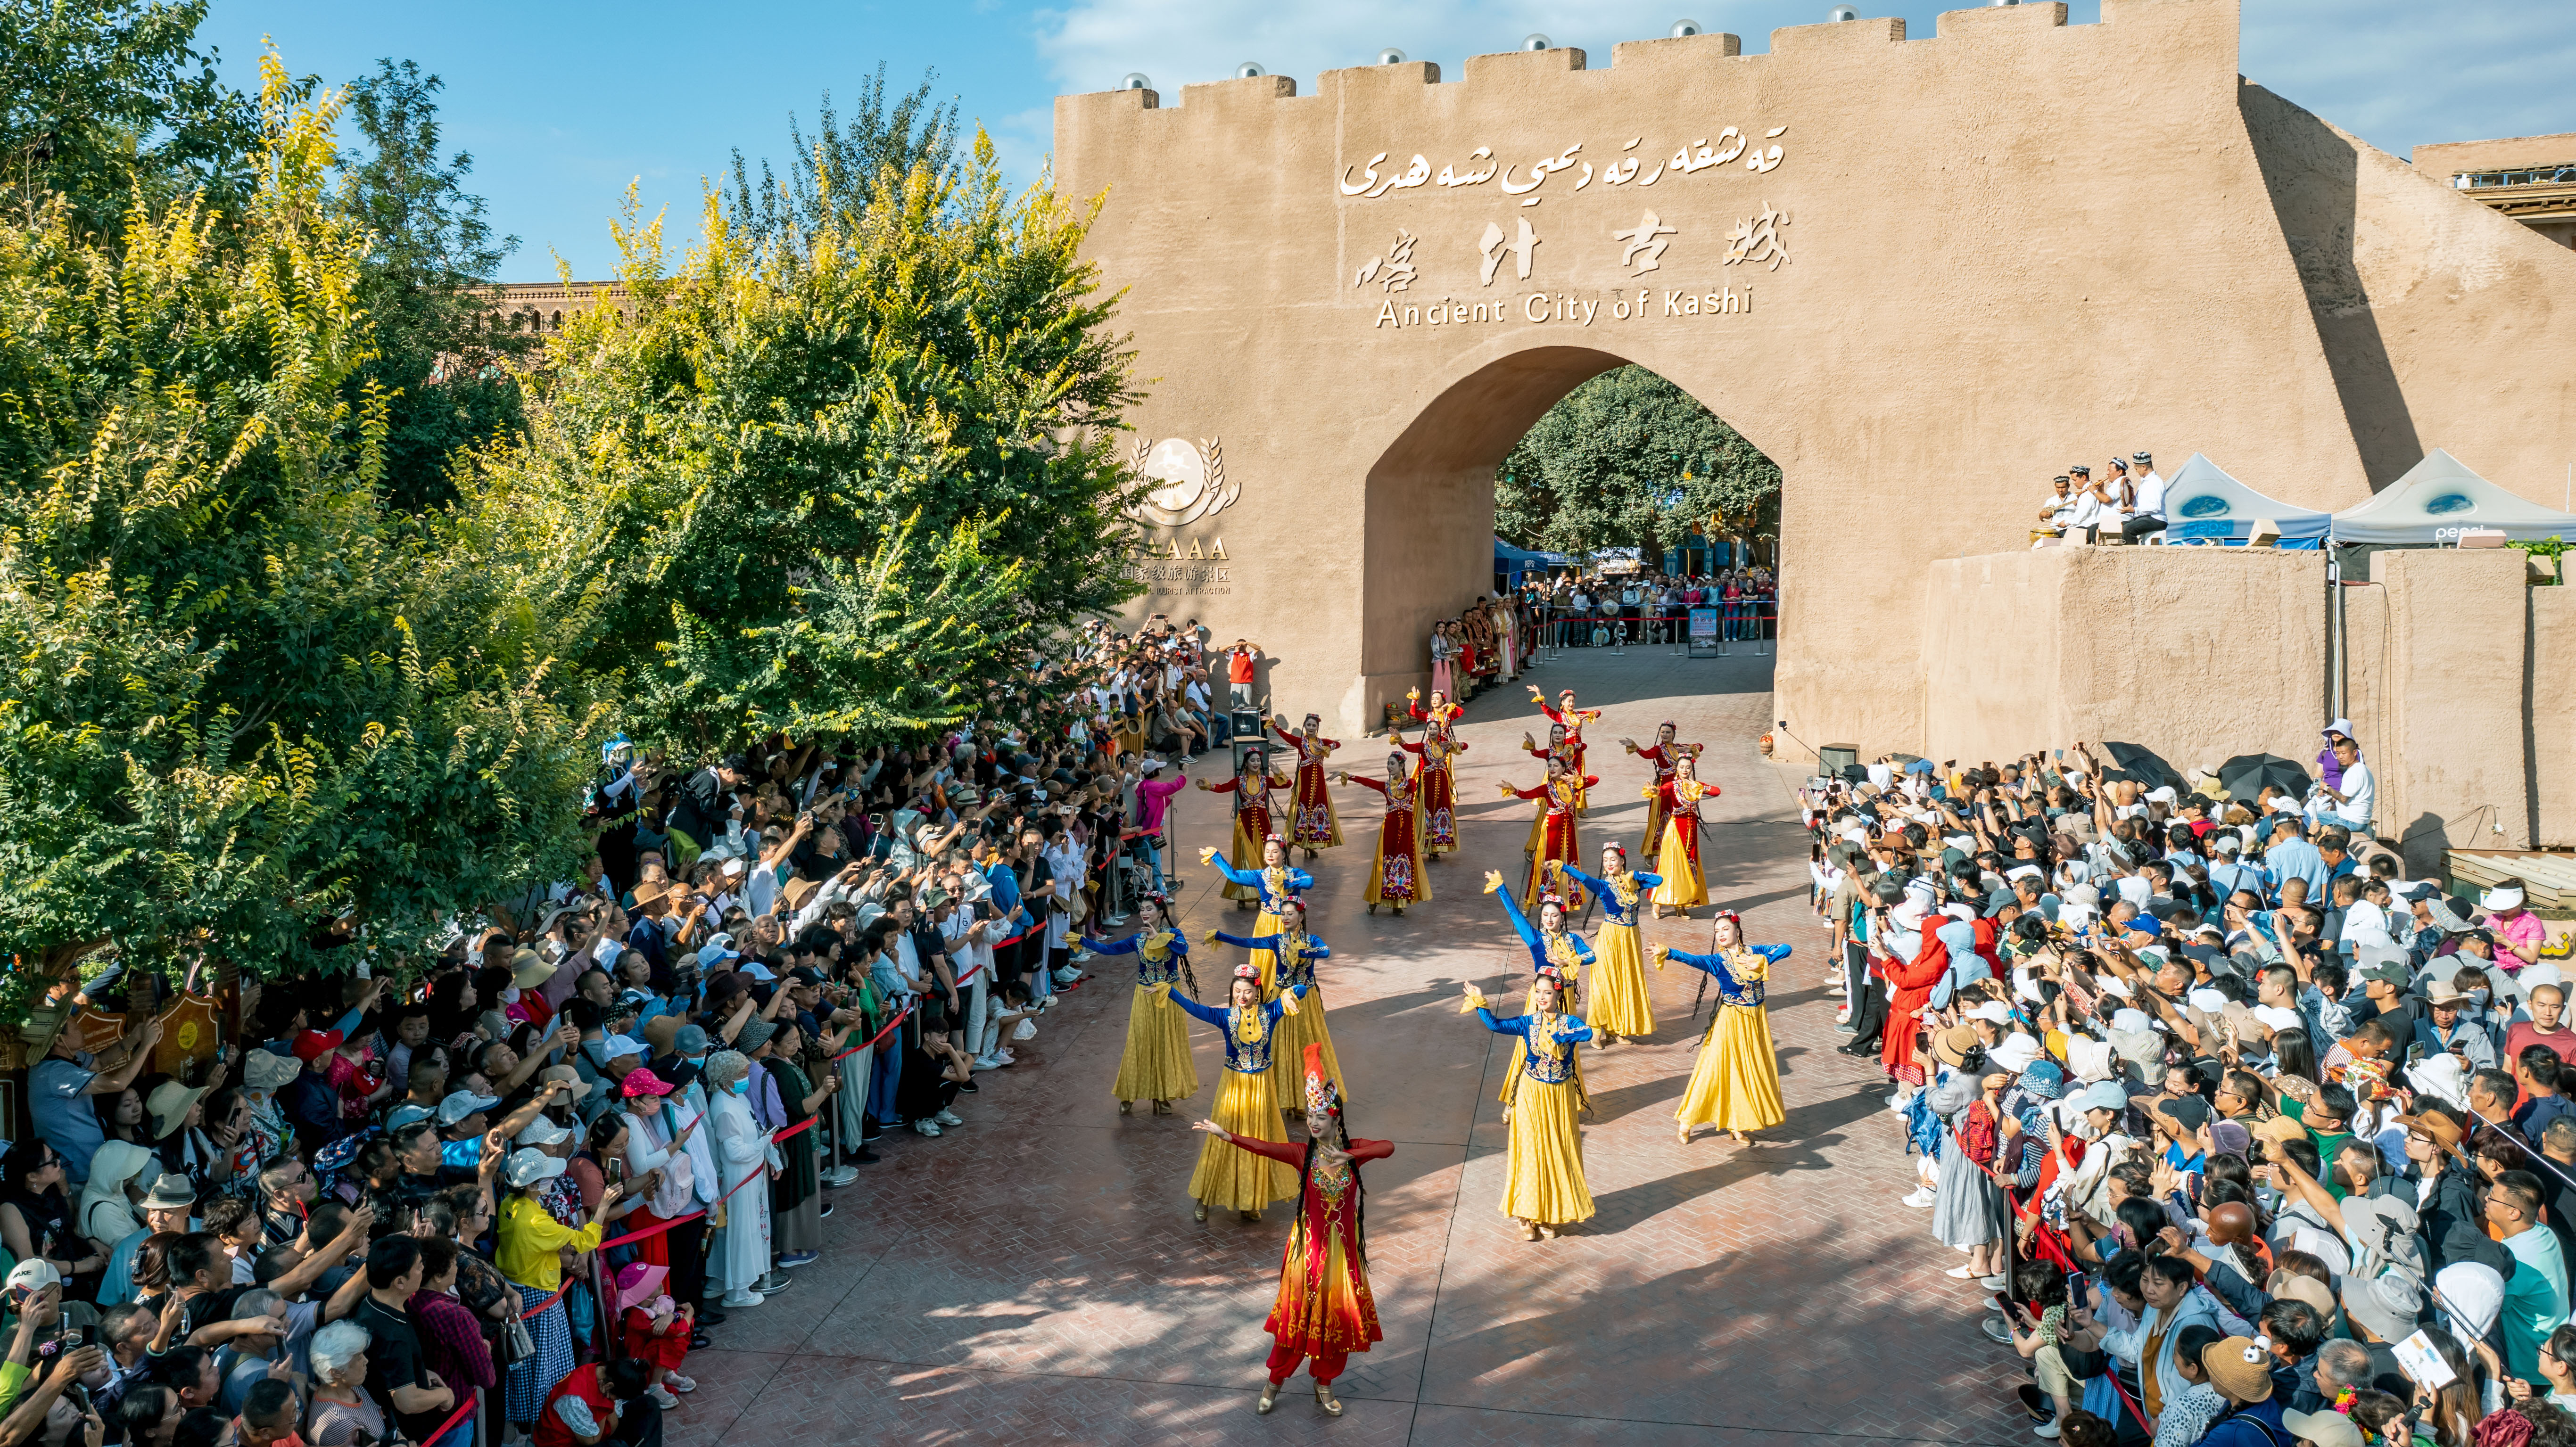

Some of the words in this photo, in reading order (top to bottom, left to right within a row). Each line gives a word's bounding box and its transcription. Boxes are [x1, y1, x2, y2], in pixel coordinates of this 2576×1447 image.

[1354, 200, 1791, 292] 喀什古城
[1375, 296, 1504, 328] Ancient
[1525, 292, 1599, 327] City
[1613, 289, 1650, 320] of
[1664, 284, 1752, 317] Kashi
[2187, 520, 2232, 536] pepsi
[1121, 564, 1230, 583] 国家级旅游景区
[1156, 587, 1182, 595] TOURIST
[1185, 586, 1230, 595] ATTRACTION
